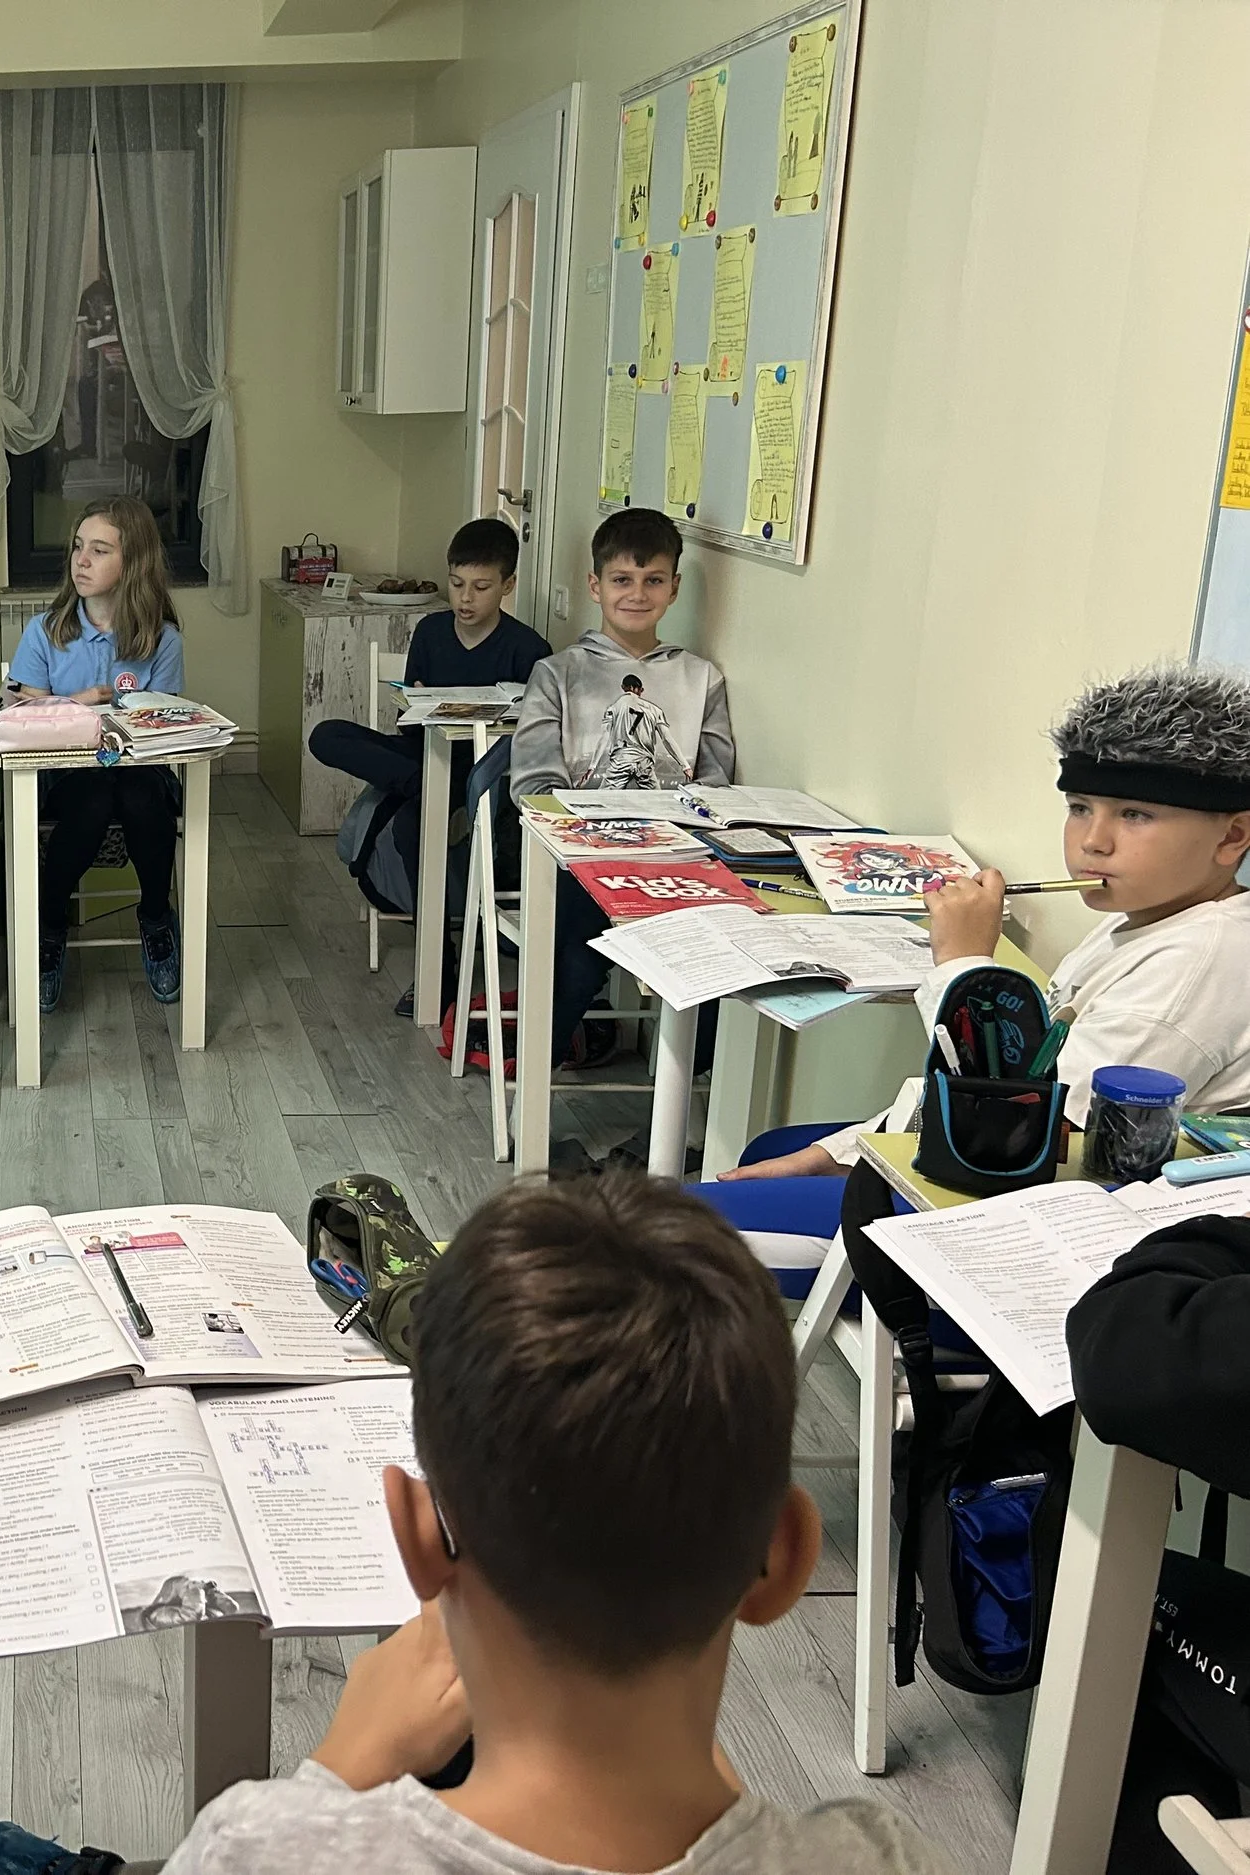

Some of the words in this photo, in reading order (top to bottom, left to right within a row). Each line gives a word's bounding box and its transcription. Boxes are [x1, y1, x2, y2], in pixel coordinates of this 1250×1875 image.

[596, 875, 702, 890] Kid's
[996, 991, 1025, 1012] GO!
[1125, 1094, 1163, 1104] Schneider
[336, 1300, 363, 1332] MICKEY
[1166, 1630, 1236, 1695] TOMMY
